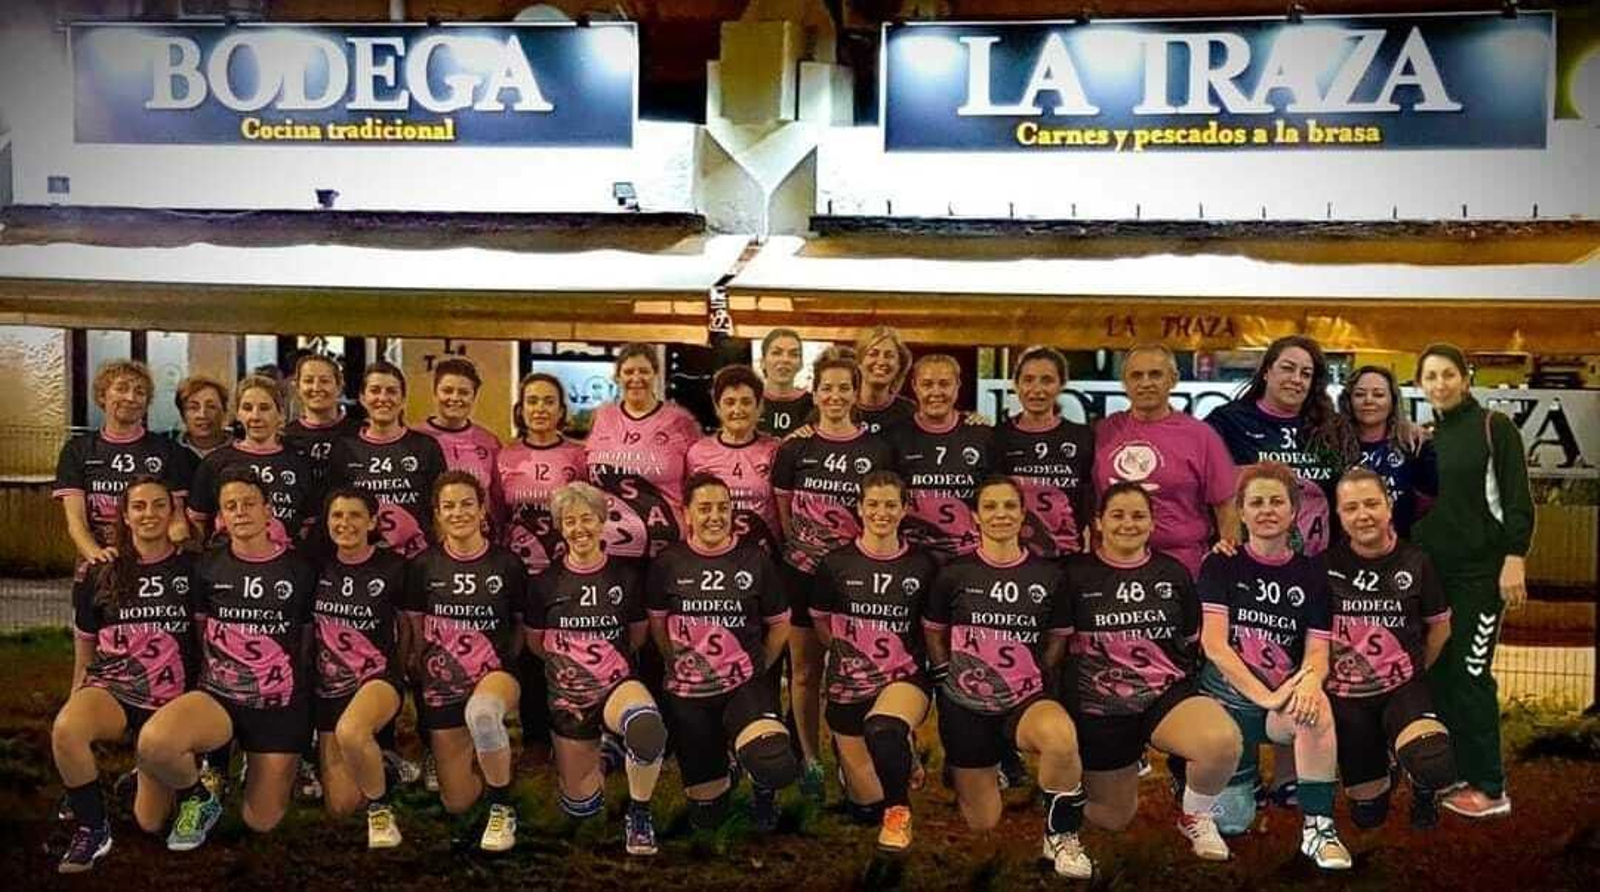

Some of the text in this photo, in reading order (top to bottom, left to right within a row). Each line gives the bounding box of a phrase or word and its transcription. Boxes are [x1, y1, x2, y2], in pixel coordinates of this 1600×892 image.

[144, 34, 554, 113] BODEGA
[957, 26, 1462, 117] LA TRAZA
[241, 117, 455, 141] Cocina tradicional
[1016, 119, 1381, 153] Carnes y pescados a la brasa
[1107, 315, 1137, 337] LA
[773, 413, 791, 429] 10
[622, 430, 641, 445] 19
[935, 446, 947, 465] 7
[1034, 443, 1048, 460] 9
[110, 453, 136, 473] 43
[368, 457, 393, 473] 24
[535, 463, 551, 481] 12
[732, 462, 743, 480] 4
[823, 452, 848, 474] 44
[804, 476, 861, 495] BODEGA
[911, 474, 974, 486] BODEGA
[138, 576, 164, 598] 25
[243, 576, 264, 599] 16
[341, 576, 354, 597] 8
[453, 573, 476, 594] 55
[700, 570, 725, 590] 22
[872, 573, 892, 594] 17
[1352, 569, 1380, 592] 42
[580, 585, 597, 606] 21
[989, 580, 1019, 602] 40
[1116, 581, 1146, 603] 48
[1255, 578, 1281, 604] 30
[119, 605, 187, 620] BODEGA
[218, 606, 284, 621] BODEGA
[315, 599, 373, 617] BODEGA
[434, 604, 494, 616] BODEGA
[682, 599, 743, 612] BODEGA
[1342, 599, 1403, 613] BODEGA
[559, 616, 619, 628] BODEGA
[971, 611, 1037, 627] BODEGA
[1095, 609, 1167, 626] BODEGA
[1237, 608, 1298, 630] BODEGA
